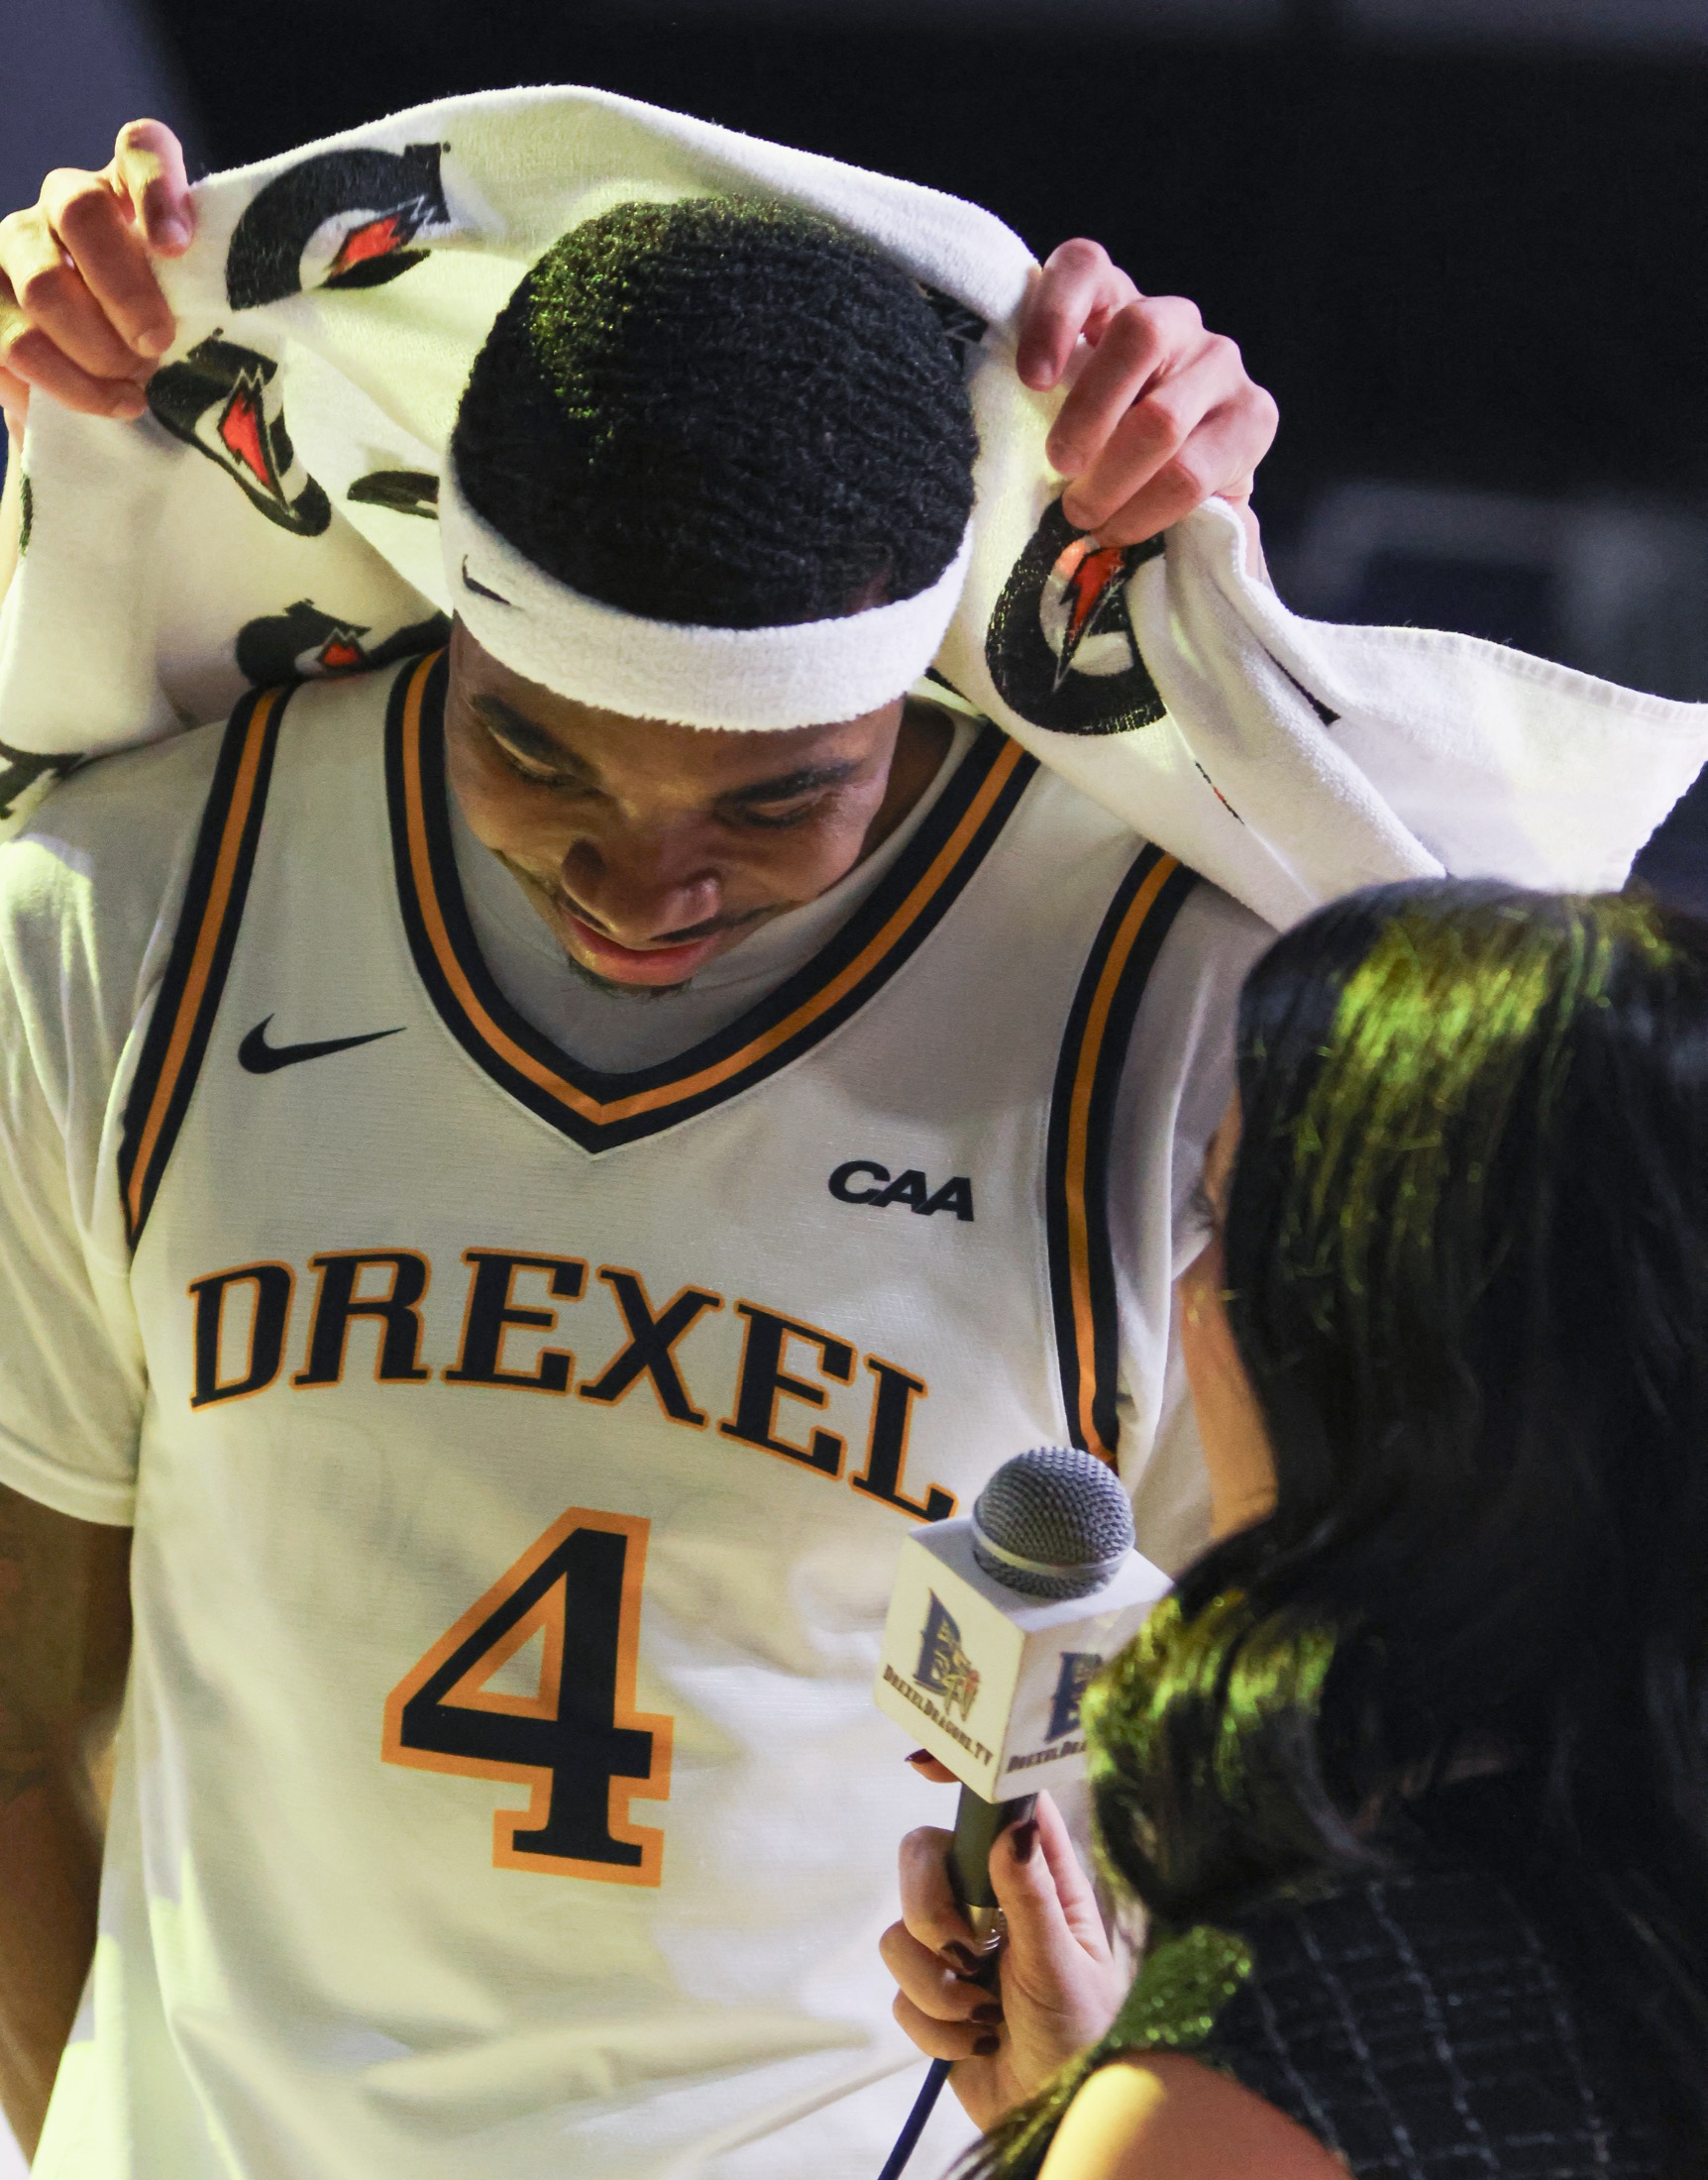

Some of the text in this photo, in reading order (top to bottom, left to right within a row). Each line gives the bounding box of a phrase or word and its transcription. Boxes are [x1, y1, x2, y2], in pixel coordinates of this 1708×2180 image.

[828, 1159, 975, 1222] CAA
[187, 1247, 959, 1523] DREXEL
[380, 1506, 675, 1889] 4
